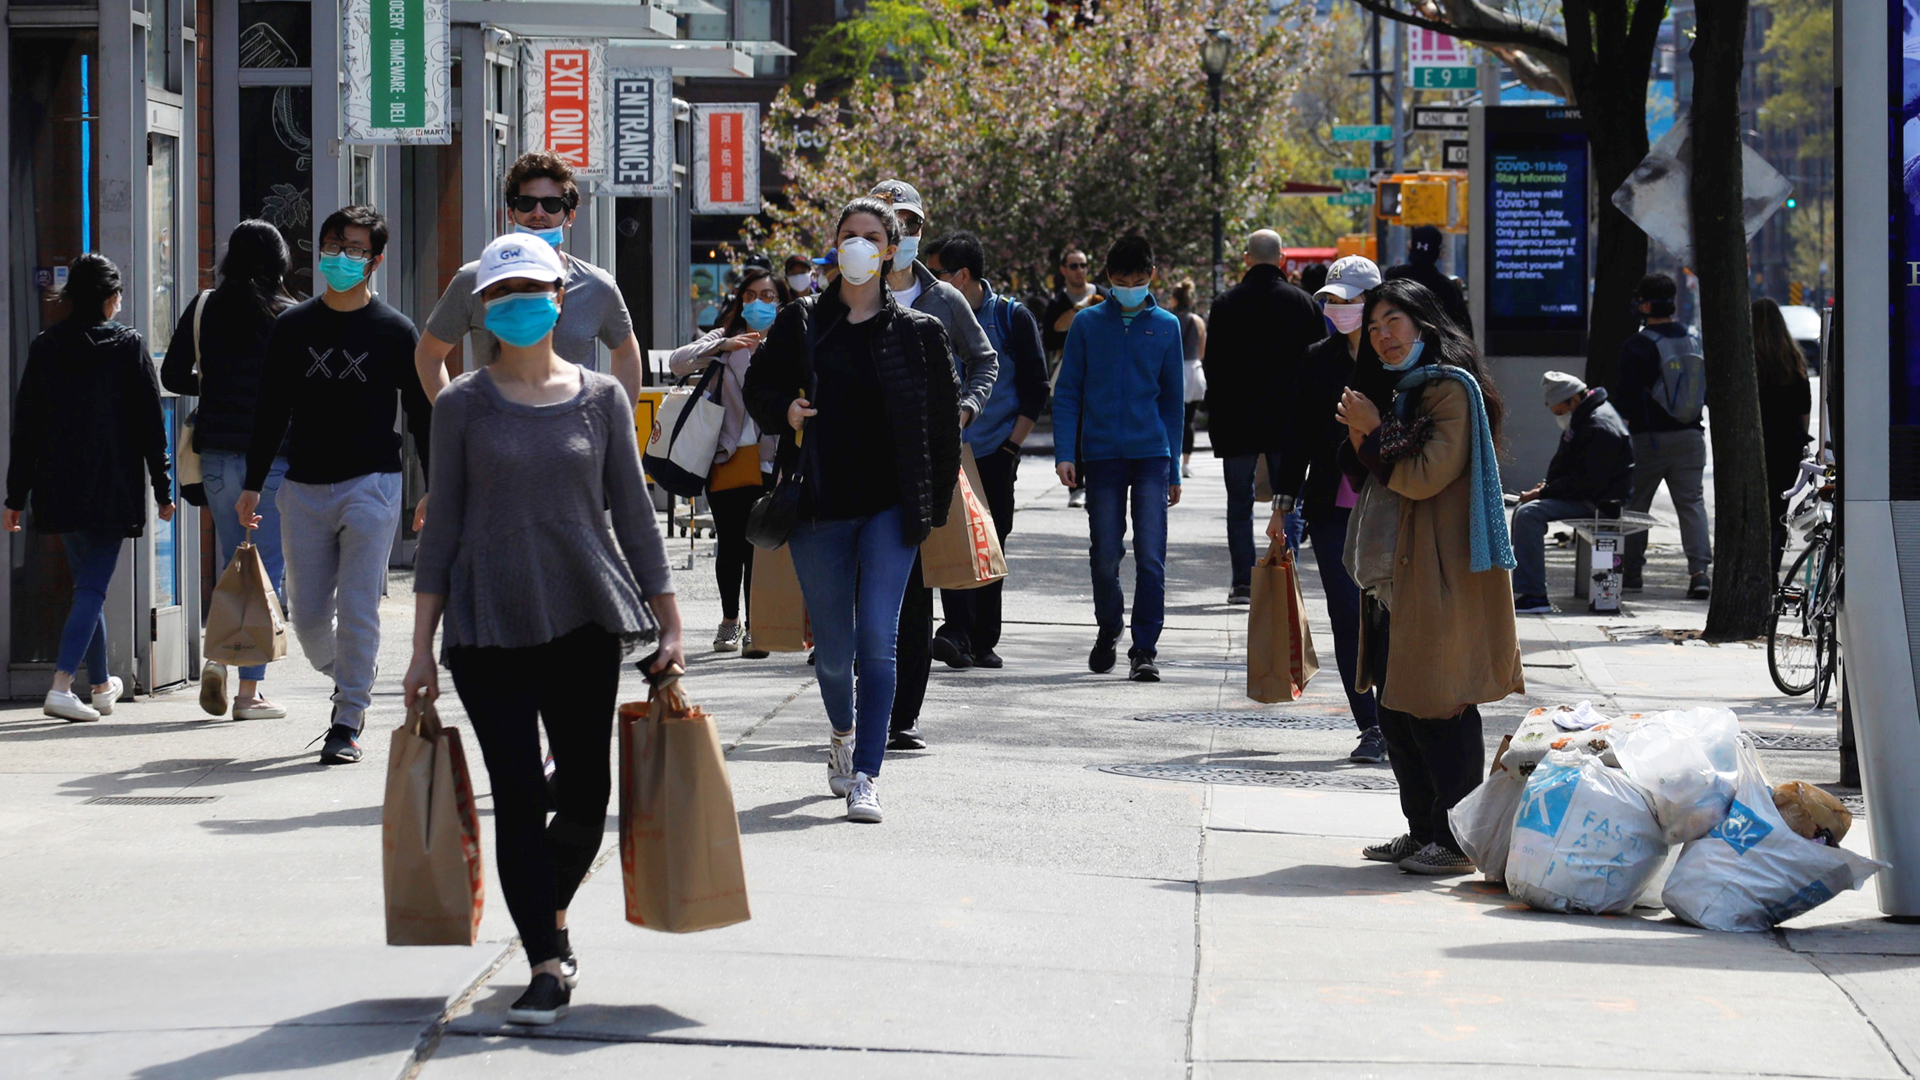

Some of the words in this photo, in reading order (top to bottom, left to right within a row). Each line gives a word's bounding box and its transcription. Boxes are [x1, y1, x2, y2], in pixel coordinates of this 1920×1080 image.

[389, 0, 405, 30] OCERY
[389, 39, 406, 93] HOMEWARE
[550, 53, 584, 101] EXIT
[1424, 69, 1434, 87] E
[1441, 69, 1451, 87] 9
[390, 102, 406, 123] DELI
[1423, 112, 1446, 125] ONE
[1456, 112, 1469, 125] WA
[618, 81, 649, 183] ENTRANCE
[720, 115, 732, 143] PRODUCE
[549, 109, 584, 163] ONLY
[721, 149, 732, 167] MEAT
[1495, 161, 1546, 172] COVID-19
[1548, 161, 1568, 172] Info
[1495, 173, 1518, 185] Stay
[1520, 172, 1567, 184] Informed
[722, 172, 733, 200] SEAFOOD
[1503, 192, 1520, 201] you
[1521, 190, 1542, 199] have
[1543, 190, 1563, 199] mild
[1495, 199, 1540, 209] COVID-19
[1545, 209, 1564, 219] stay
[1495, 219, 1521, 228] home
[1522, 219, 1539, 228] and
[1495, 228, 1517, 238] Only
[1517, 229, 1529, 238] go
[1530, 228, 1540, 237] to
[1541, 228, 1556, 237] the
[1495, 239, 1544, 248] emergency
[1545, 239, 1569, 247] room
[1570, 237, 1577, 247] if
[500, 248, 521, 260] GW
[1495, 248, 1513, 258] you
[1514, 248, 1528, 256] are
[1529, 247, 1565, 258] severely
[1328, 265, 1342, 280] A
[1495, 261, 1528, 270] Protect
[1529, 261, 1564, 271] yourself
[1495, 270, 1513, 279] and
[1541, 304, 1560, 314] Notify
[1561, 304, 1578, 312] NYC
